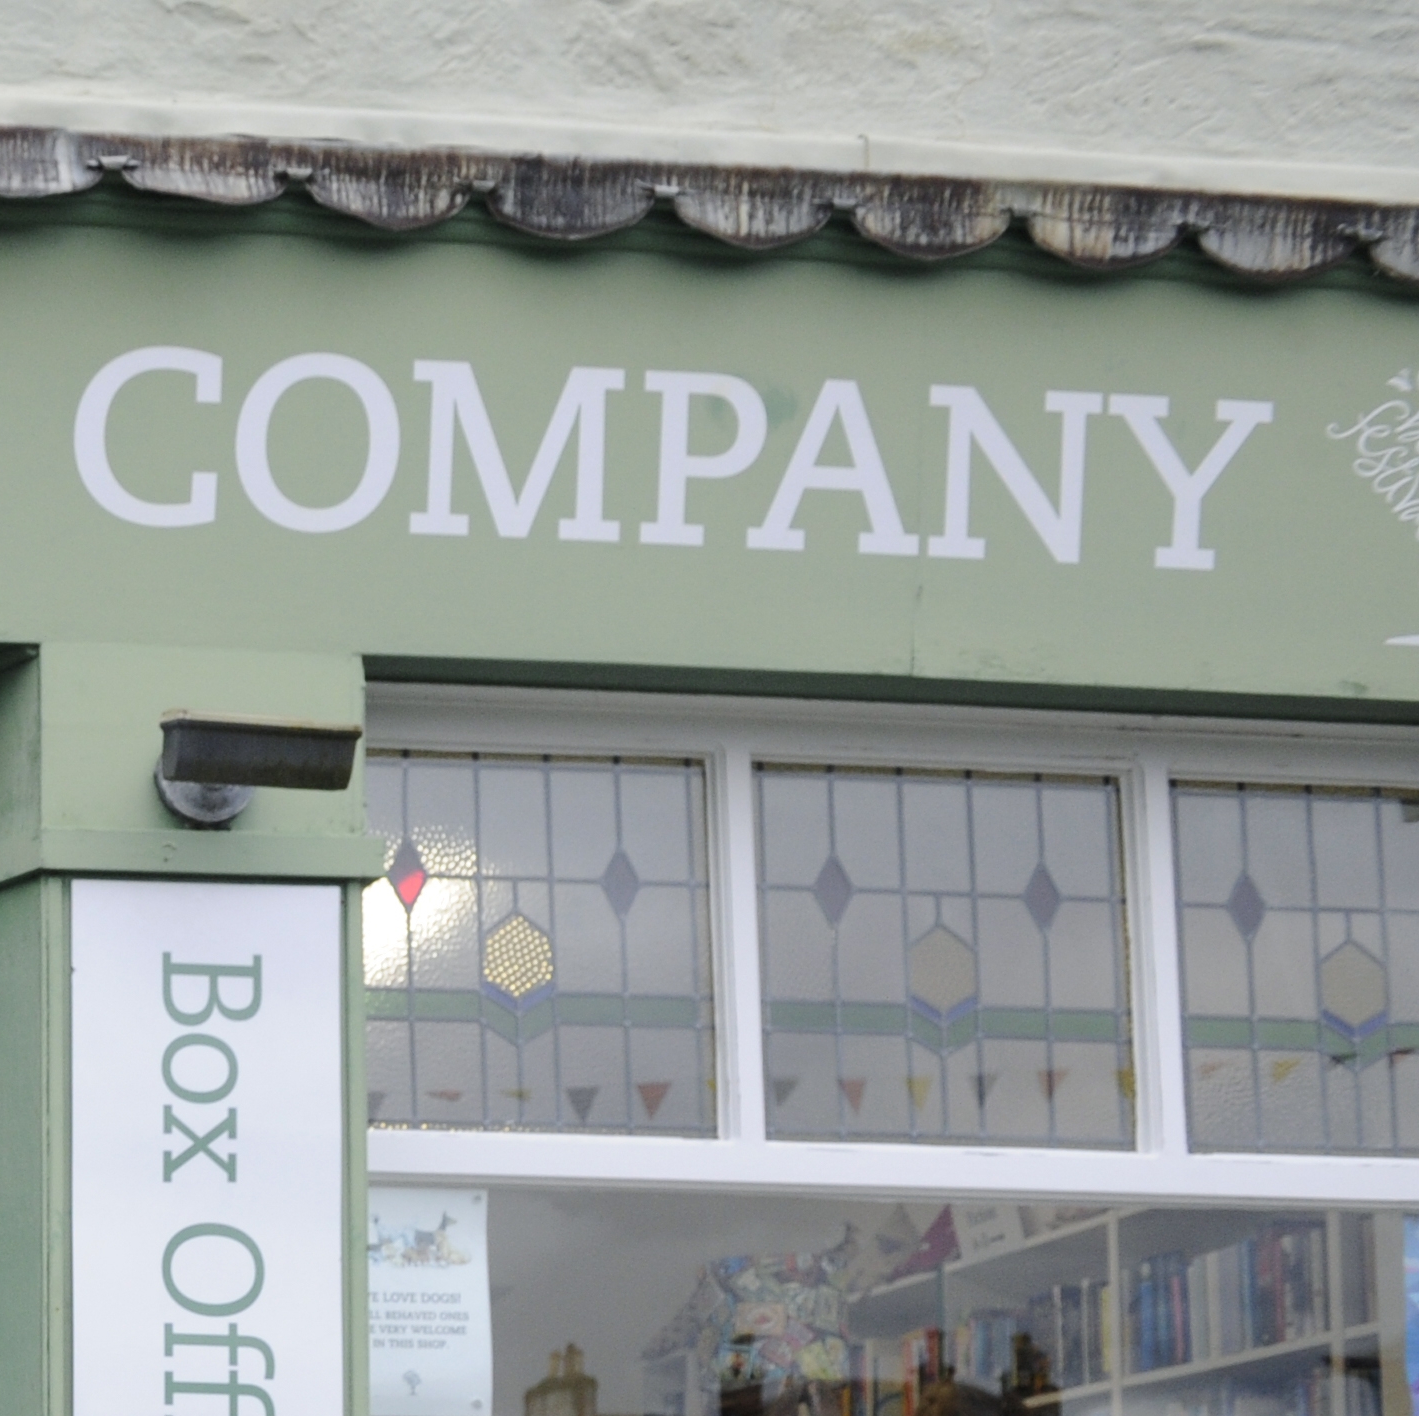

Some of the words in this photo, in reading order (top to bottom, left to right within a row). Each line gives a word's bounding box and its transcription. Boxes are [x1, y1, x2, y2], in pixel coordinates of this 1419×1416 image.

[74, 346, 1273, 570] COMPANY
[162, 951, 264, 1183] Box
[383, 1292, 418, 1304] LOVE
[421, 1292, 461, 1305] DOGS!
[385, 1311, 437, 1321] BEHAVED
[439, 1311, 470, 1322] ONES
[379, 1325, 407, 1336] VERY
[412, 1325, 467, 1336] WELCOME
[372, 1338, 385, 1348] IN
[388, 1339, 414, 1349] THIS
